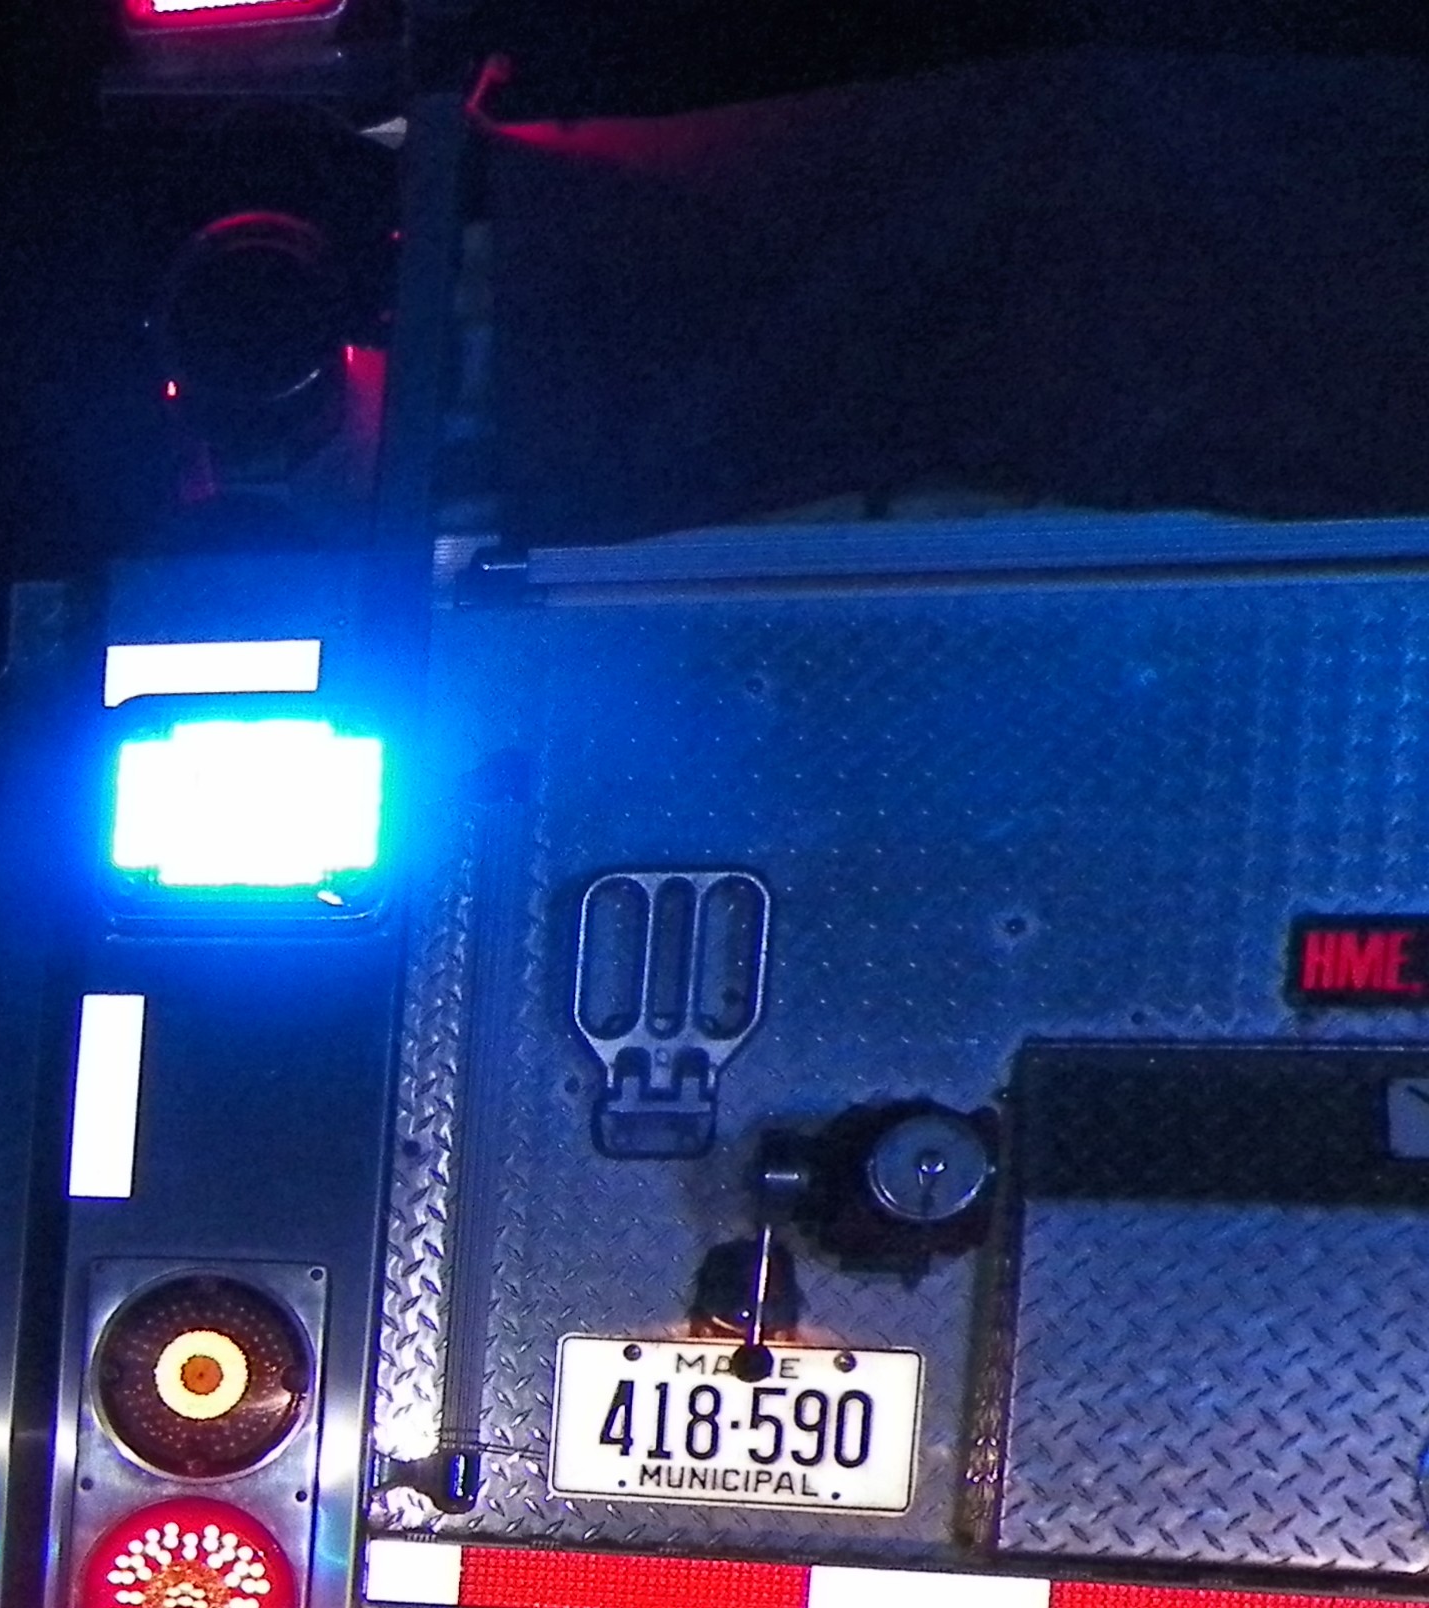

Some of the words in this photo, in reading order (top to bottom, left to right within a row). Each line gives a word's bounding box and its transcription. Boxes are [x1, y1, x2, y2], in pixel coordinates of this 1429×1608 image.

[1301, 931, 1424, 992] HME
[675, 1353, 801, 1380] MAE
[639, 1464, 819, 1498] MUNICIPAL
